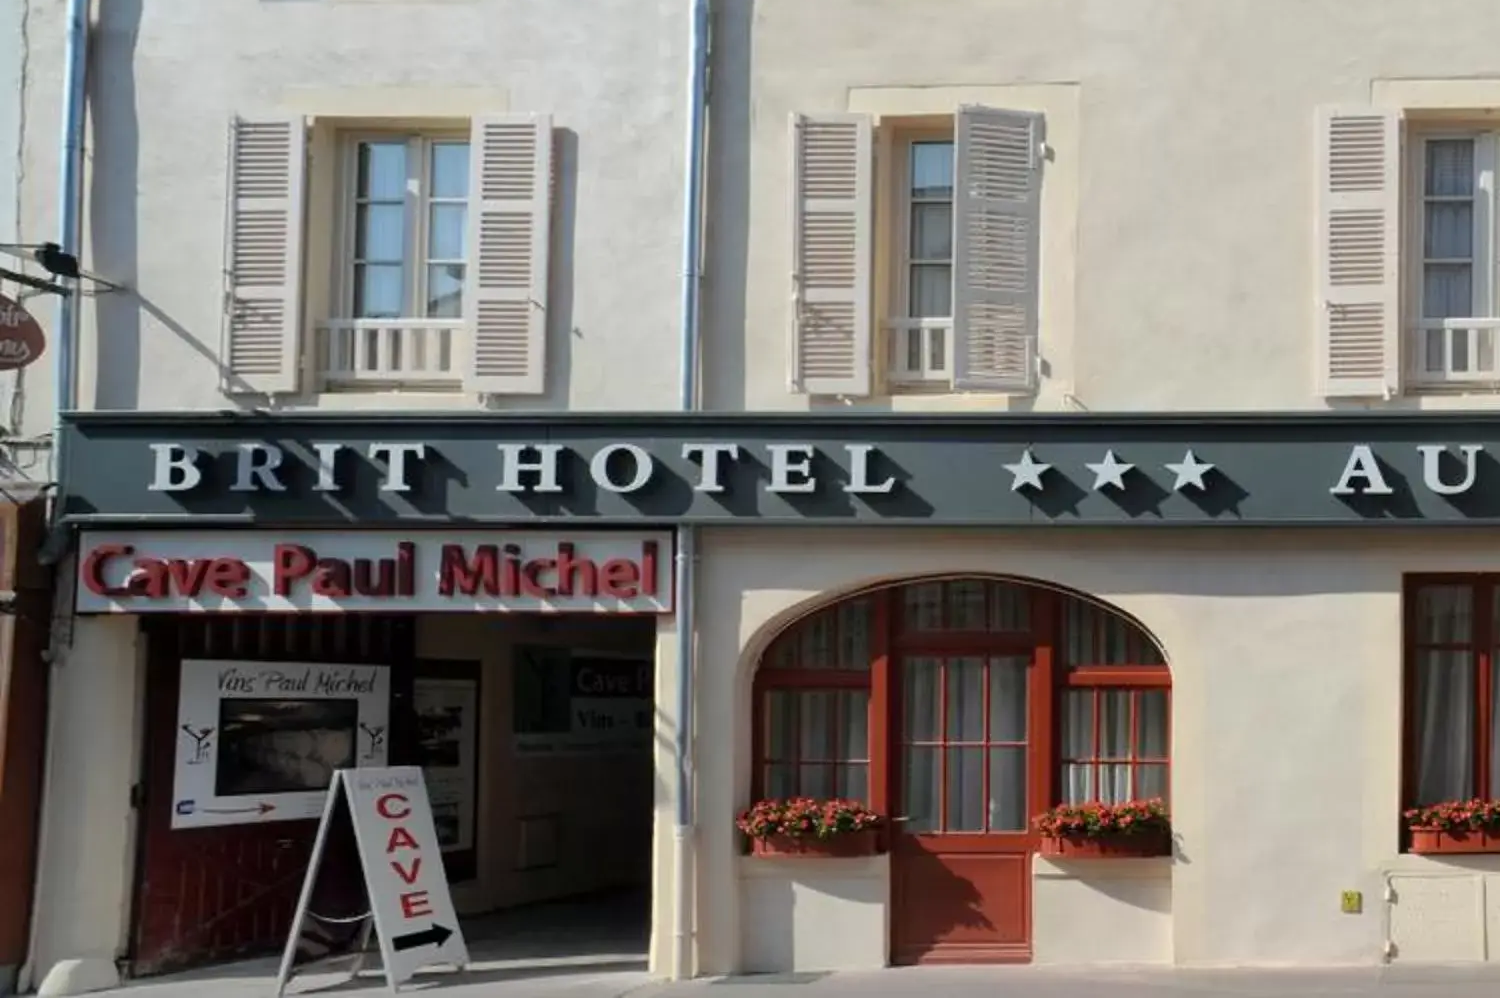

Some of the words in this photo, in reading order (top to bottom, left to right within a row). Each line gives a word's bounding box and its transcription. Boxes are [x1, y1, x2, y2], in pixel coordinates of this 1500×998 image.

[147, 443, 425, 492] BRIT
[496, 443, 898, 494] HOTEL
[1330, 443, 1484, 495] AU
[82, 544, 250, 599] Cave
[273, 541, 416, 598] Paul
[438, 539, 658, 599] Michel
[217, 667, 257, 693] Vins
[261, 668, 310, 693] Paul
[576, 666, 632, 693] Cave
[375, 793, 434, 919] CAVE
